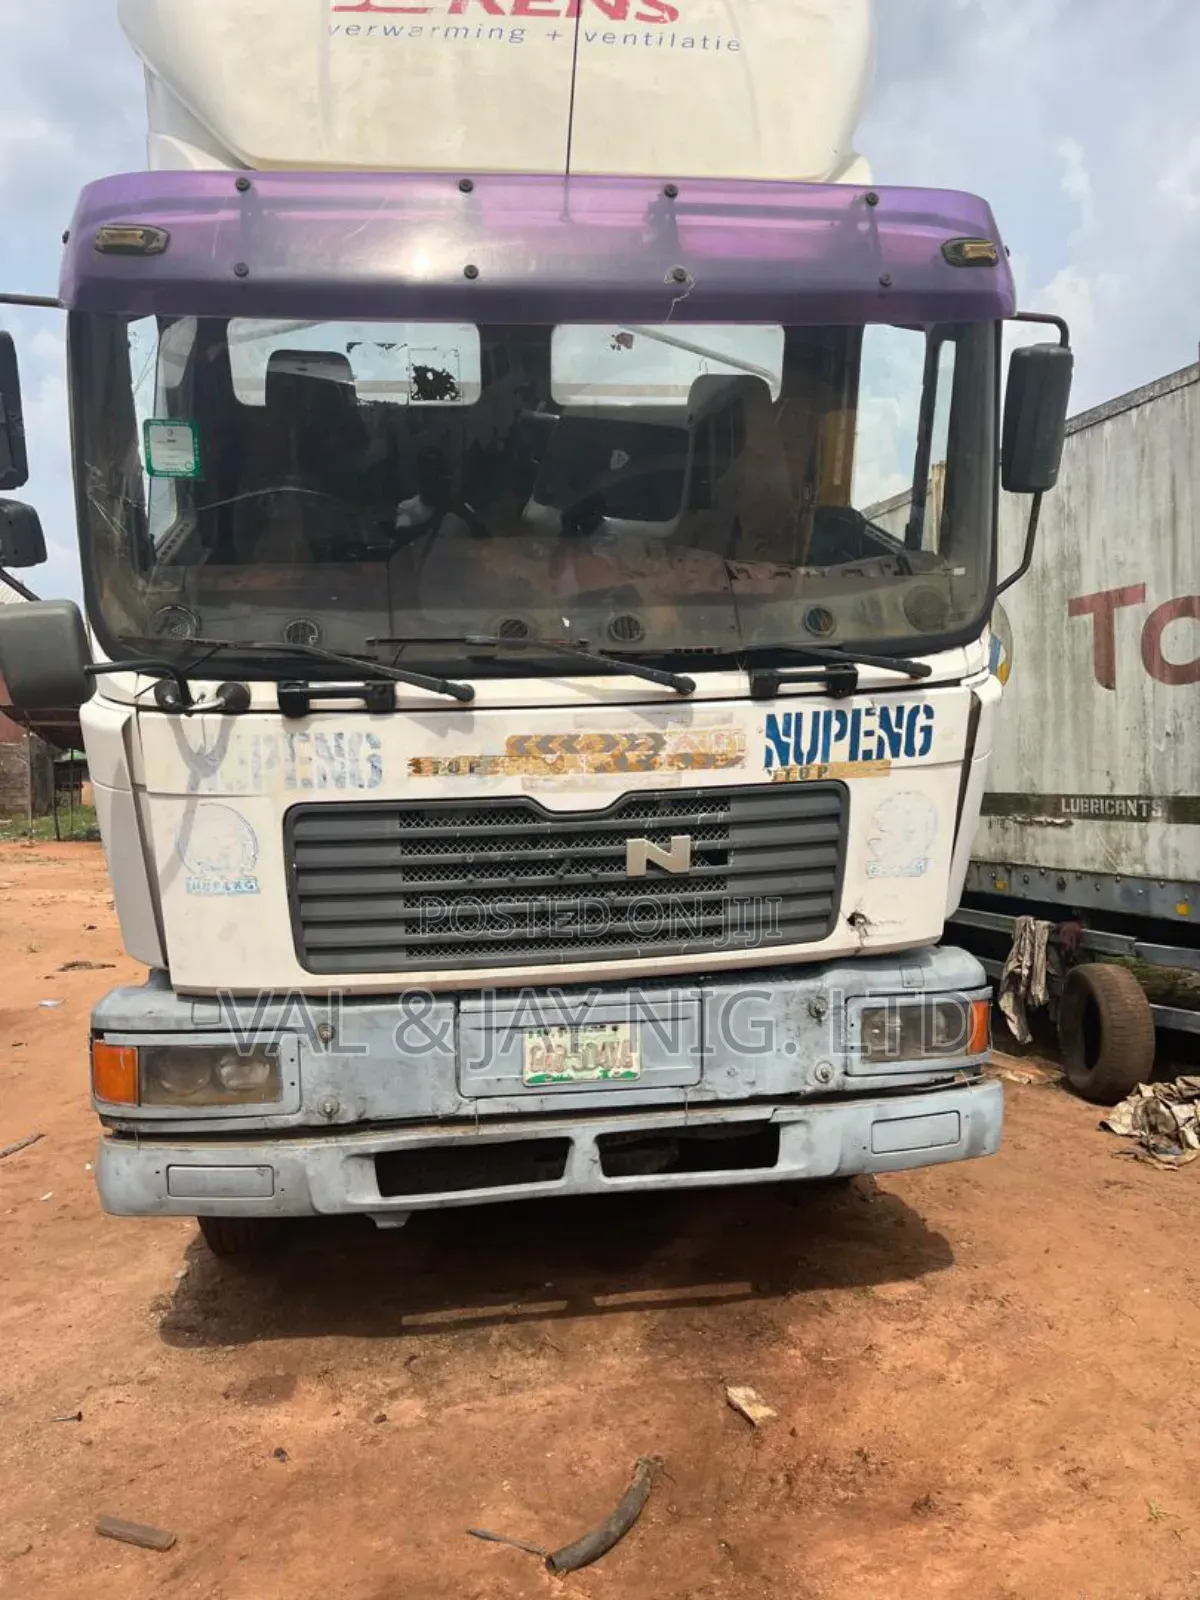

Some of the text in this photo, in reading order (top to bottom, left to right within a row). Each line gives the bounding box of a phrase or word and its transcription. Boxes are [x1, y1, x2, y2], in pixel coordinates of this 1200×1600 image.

[327, 23, 527, 44] verwarming
[584, 31, 741, 52] ventilatie
[764, 704, 935, 768] NUPENG
[1061, 797, 1163, 818] LUBRICANTS
